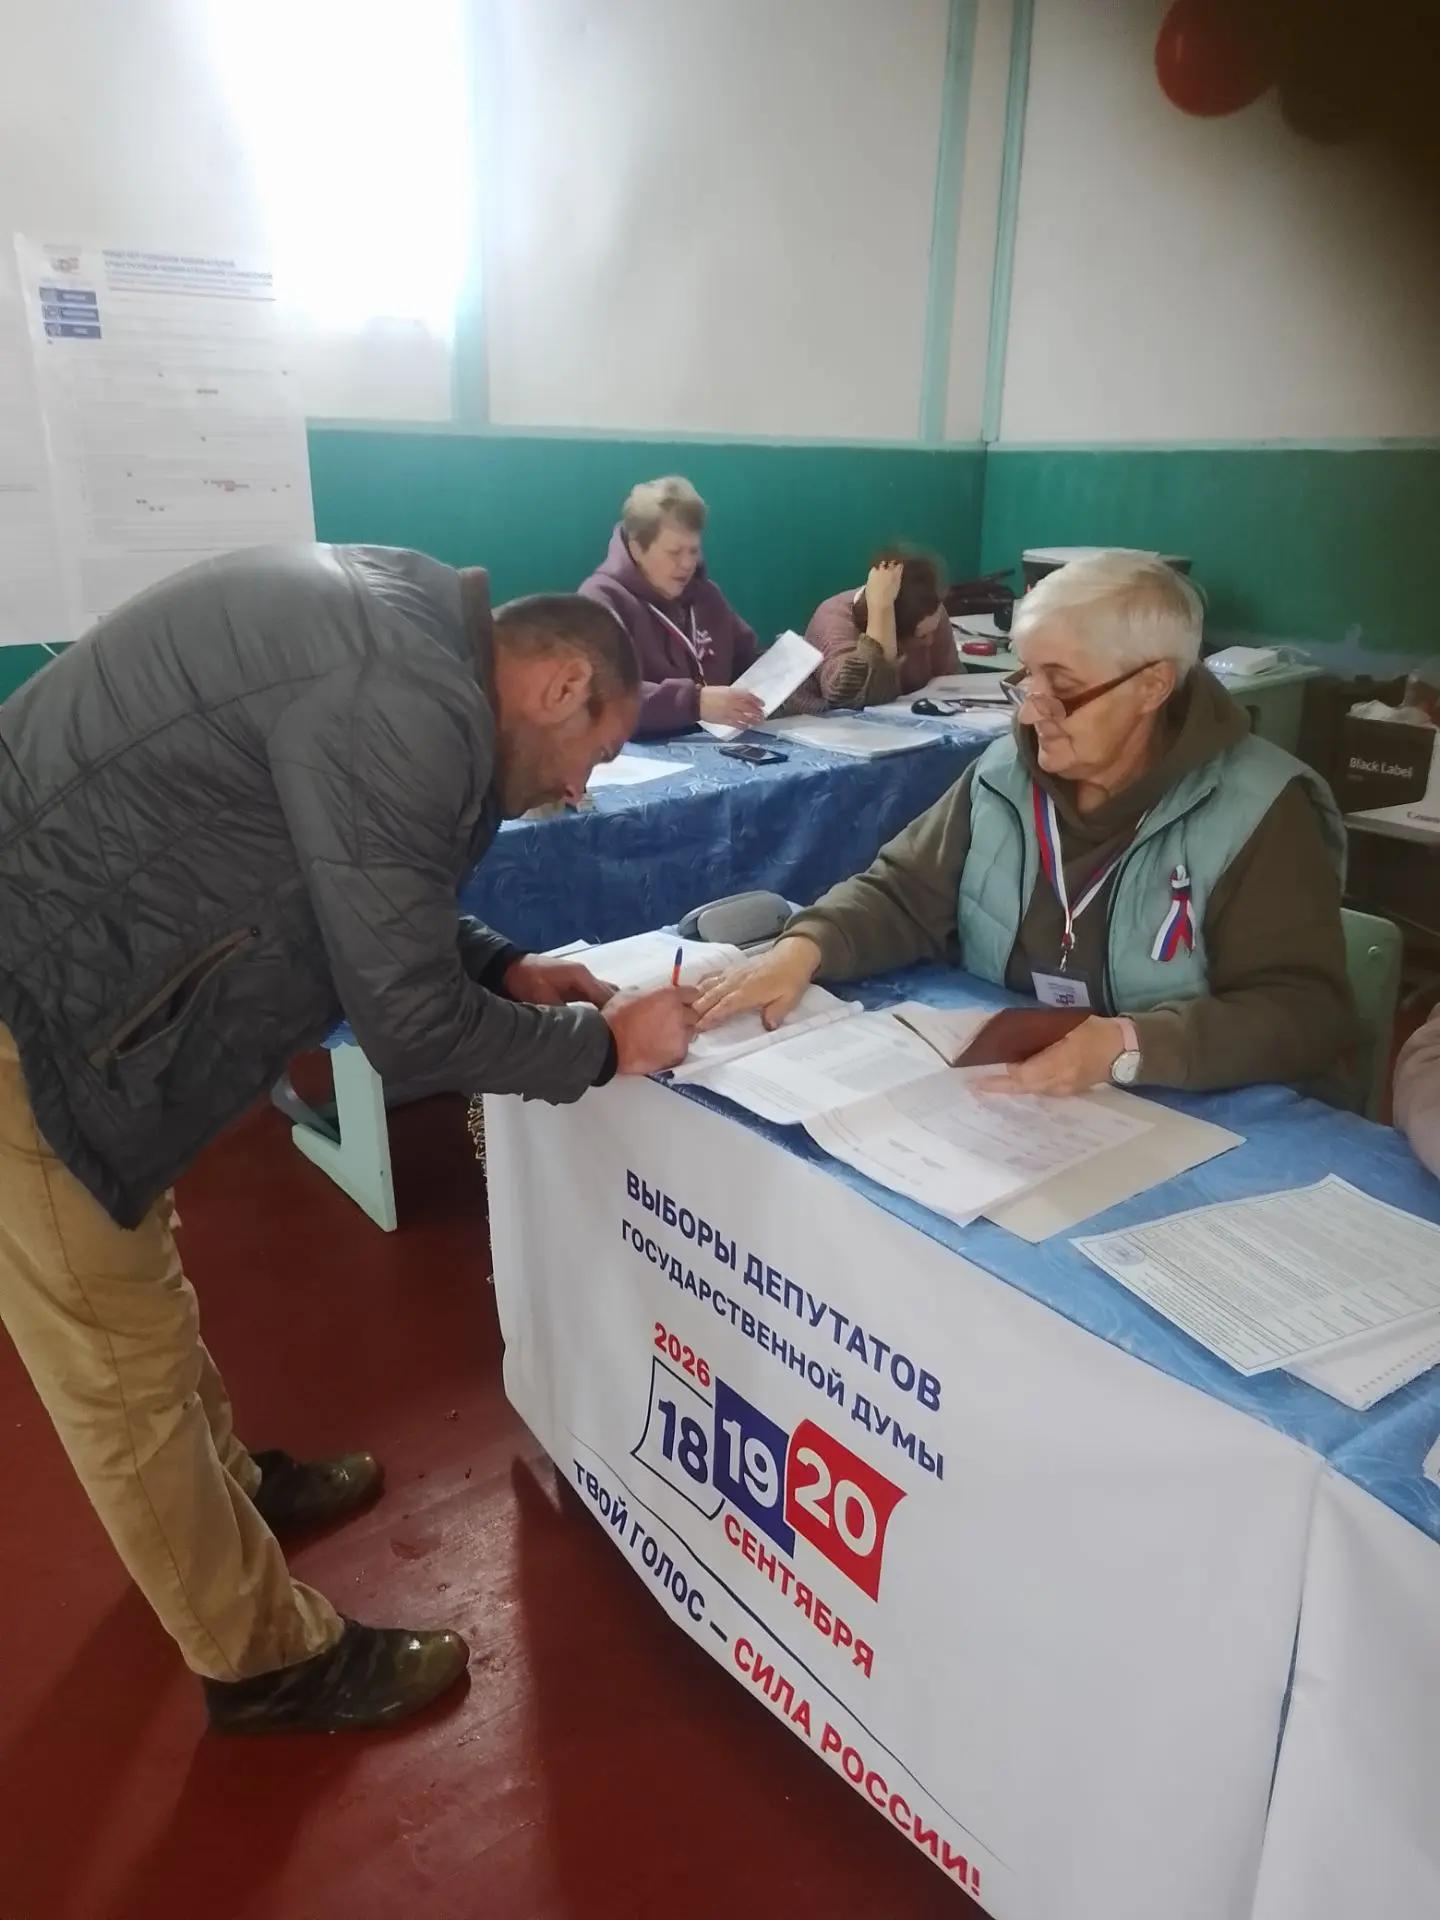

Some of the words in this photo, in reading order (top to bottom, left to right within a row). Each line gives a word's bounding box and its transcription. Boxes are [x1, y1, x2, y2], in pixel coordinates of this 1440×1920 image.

[1349, 756, 1379, 773] Black
[1380, 761, 1414, 778] Label
[621, 1217, 845, 1407] ГОСУДАРСТВЕННОЙ
[850, 1392, 945, 1480] ДУМЫ
[626, 1168, 737, 1270] ВЫБОРЫ
[743, 1252, 942, 1412] ДЕПУТАТОВ
[653, 1320, 711, 1388] 2026
[657, 1397, 708, 1485] 18
[722, 1417, 779, 1509] 19
[793, 1446, 878, 1558] 20
[572, 1458, 629, 1538] ТВОЙ
[628, 1526, 706, 1623] ГОЛОС
[733, 1636, 813, 1738] СИЛА
[820, 1721, 982, 1898] РОССИИ!
[722, 1513, 875, 1679] СЕНТЯБРЯ
